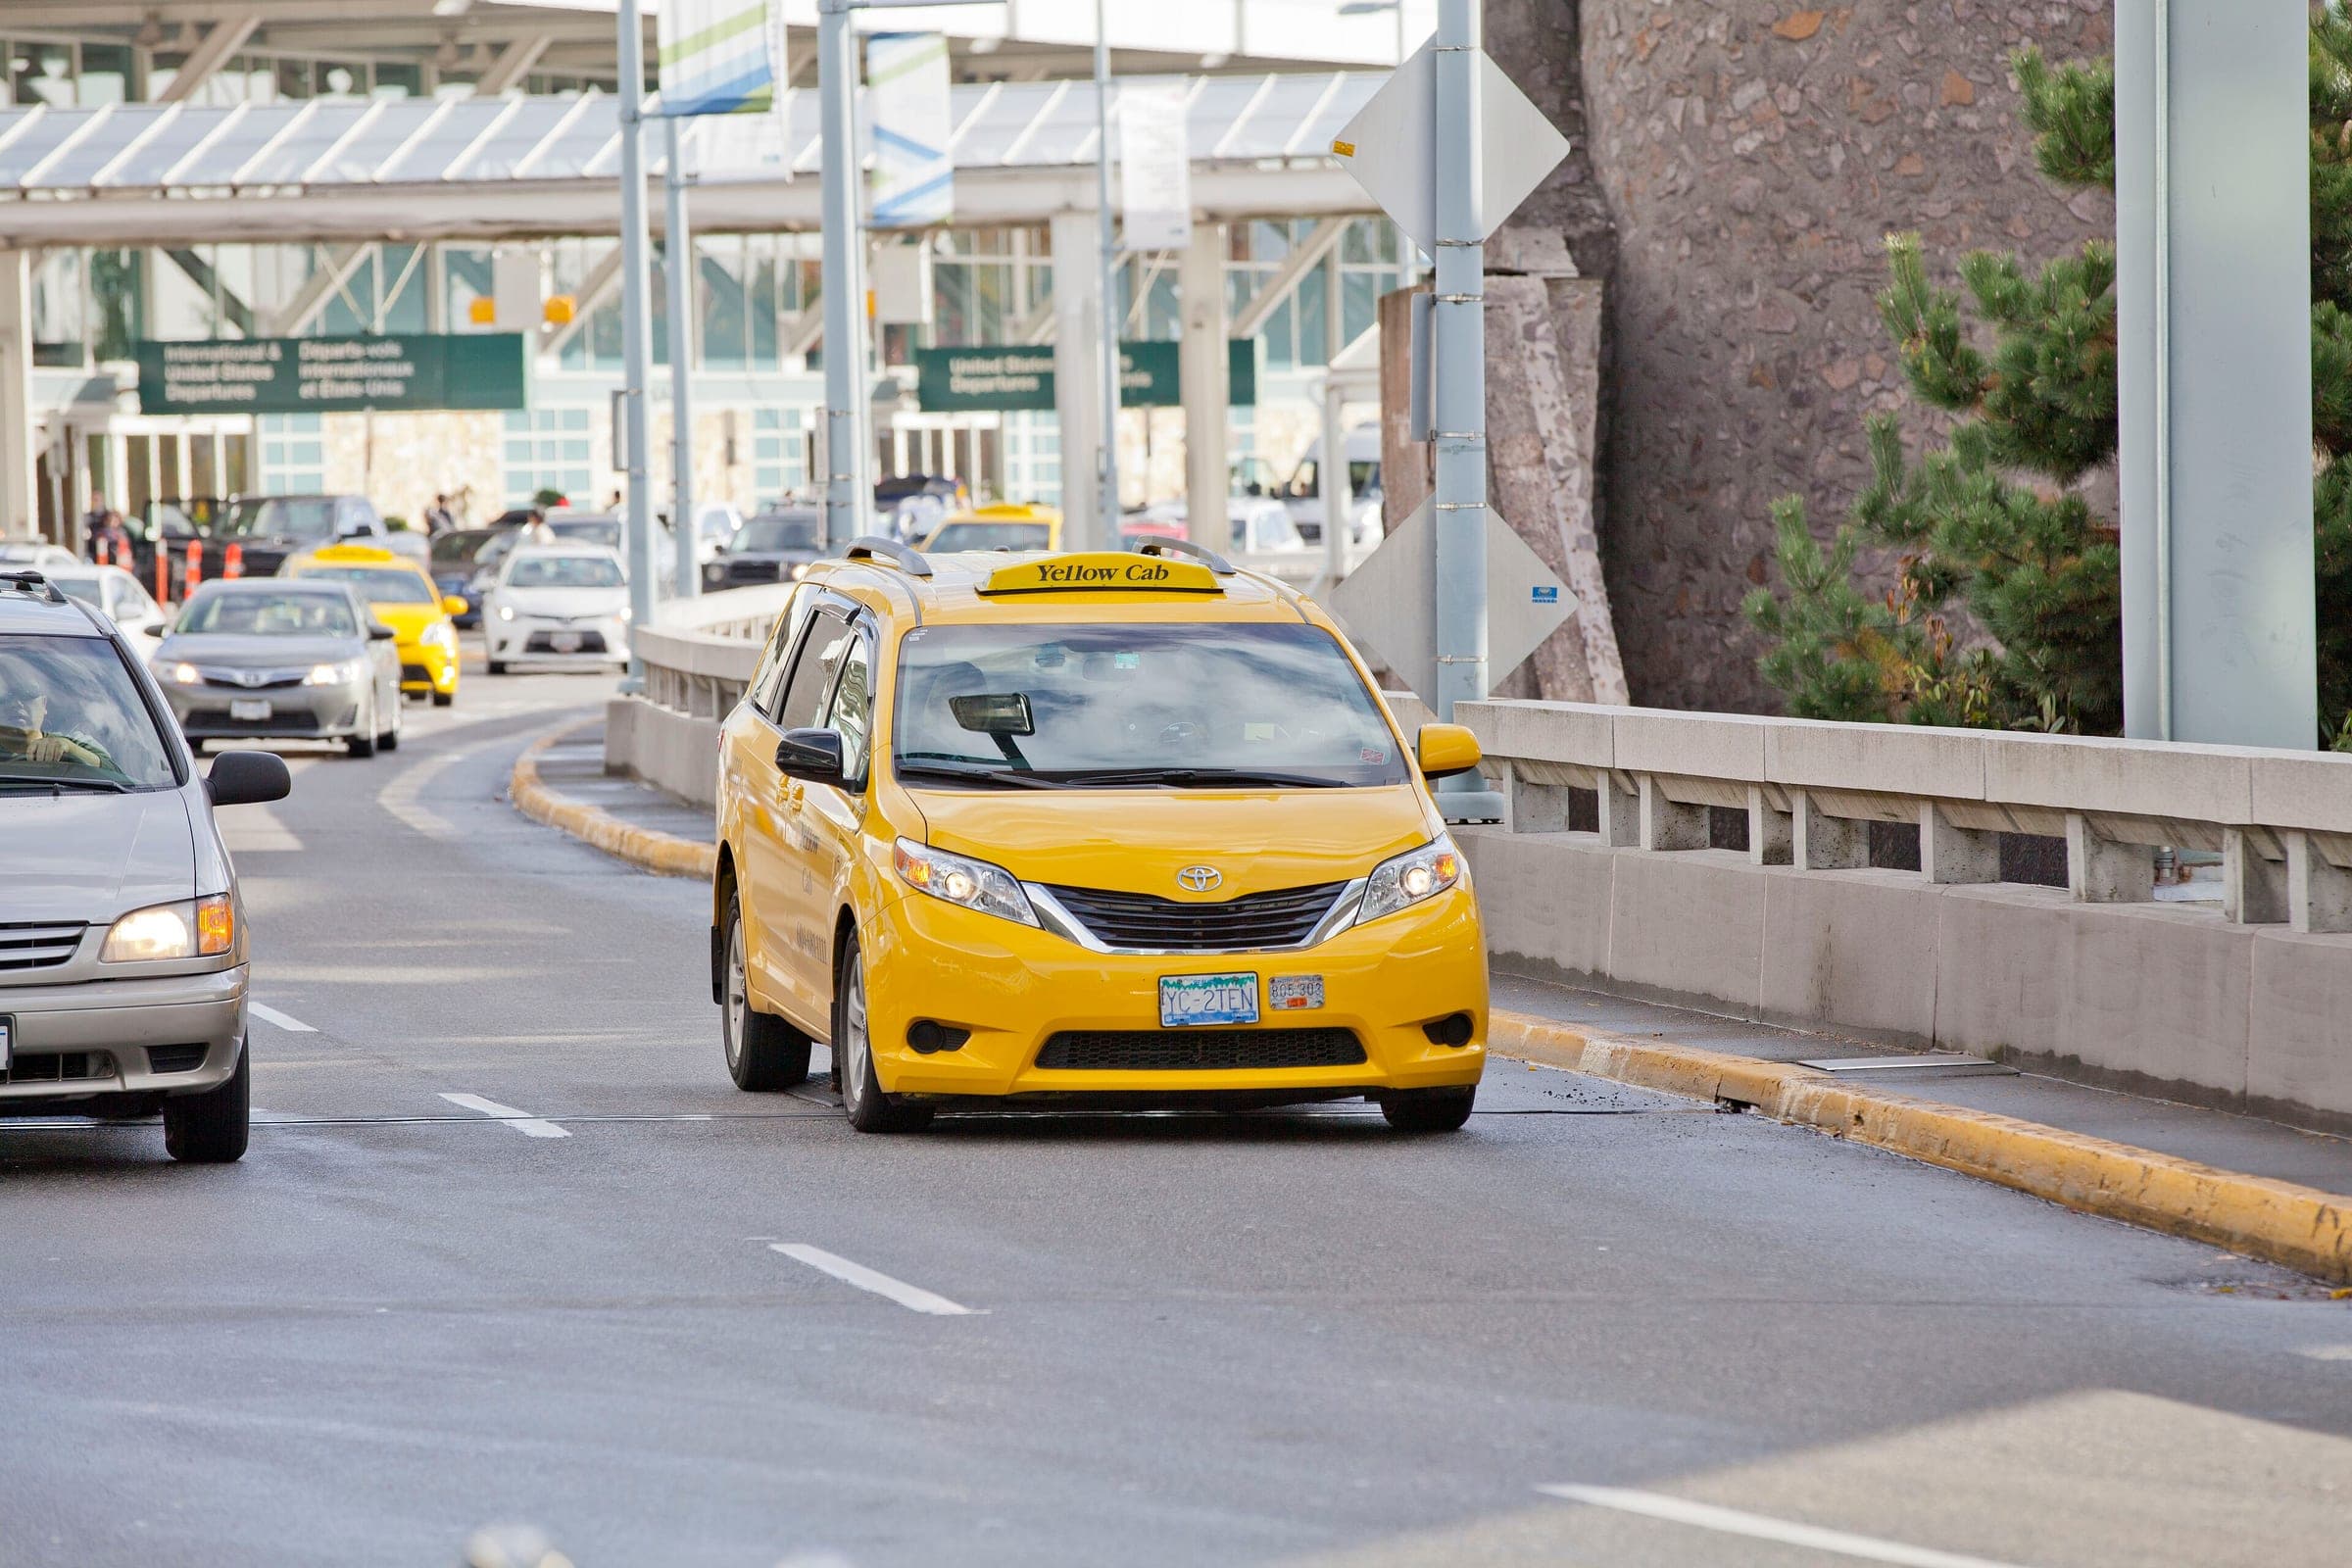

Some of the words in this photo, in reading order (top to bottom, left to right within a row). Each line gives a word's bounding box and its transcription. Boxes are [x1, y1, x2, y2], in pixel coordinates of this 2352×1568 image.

[165, 344, 266, 363] International
[165, 364, 218, 382] United
[220, 362, 274, 381] States
[950, 357, 1001, 374] United
[165, 382, 256, 404] Departures
[950, 375, 1040, 395] Departures
[1037, 564, 1119, 581] Yellow
[1126, 564, 1169, 581] Cab
[802, 867, 813, 896] Cab
[1166, 988, 1253, 1012] YC-2TEN
